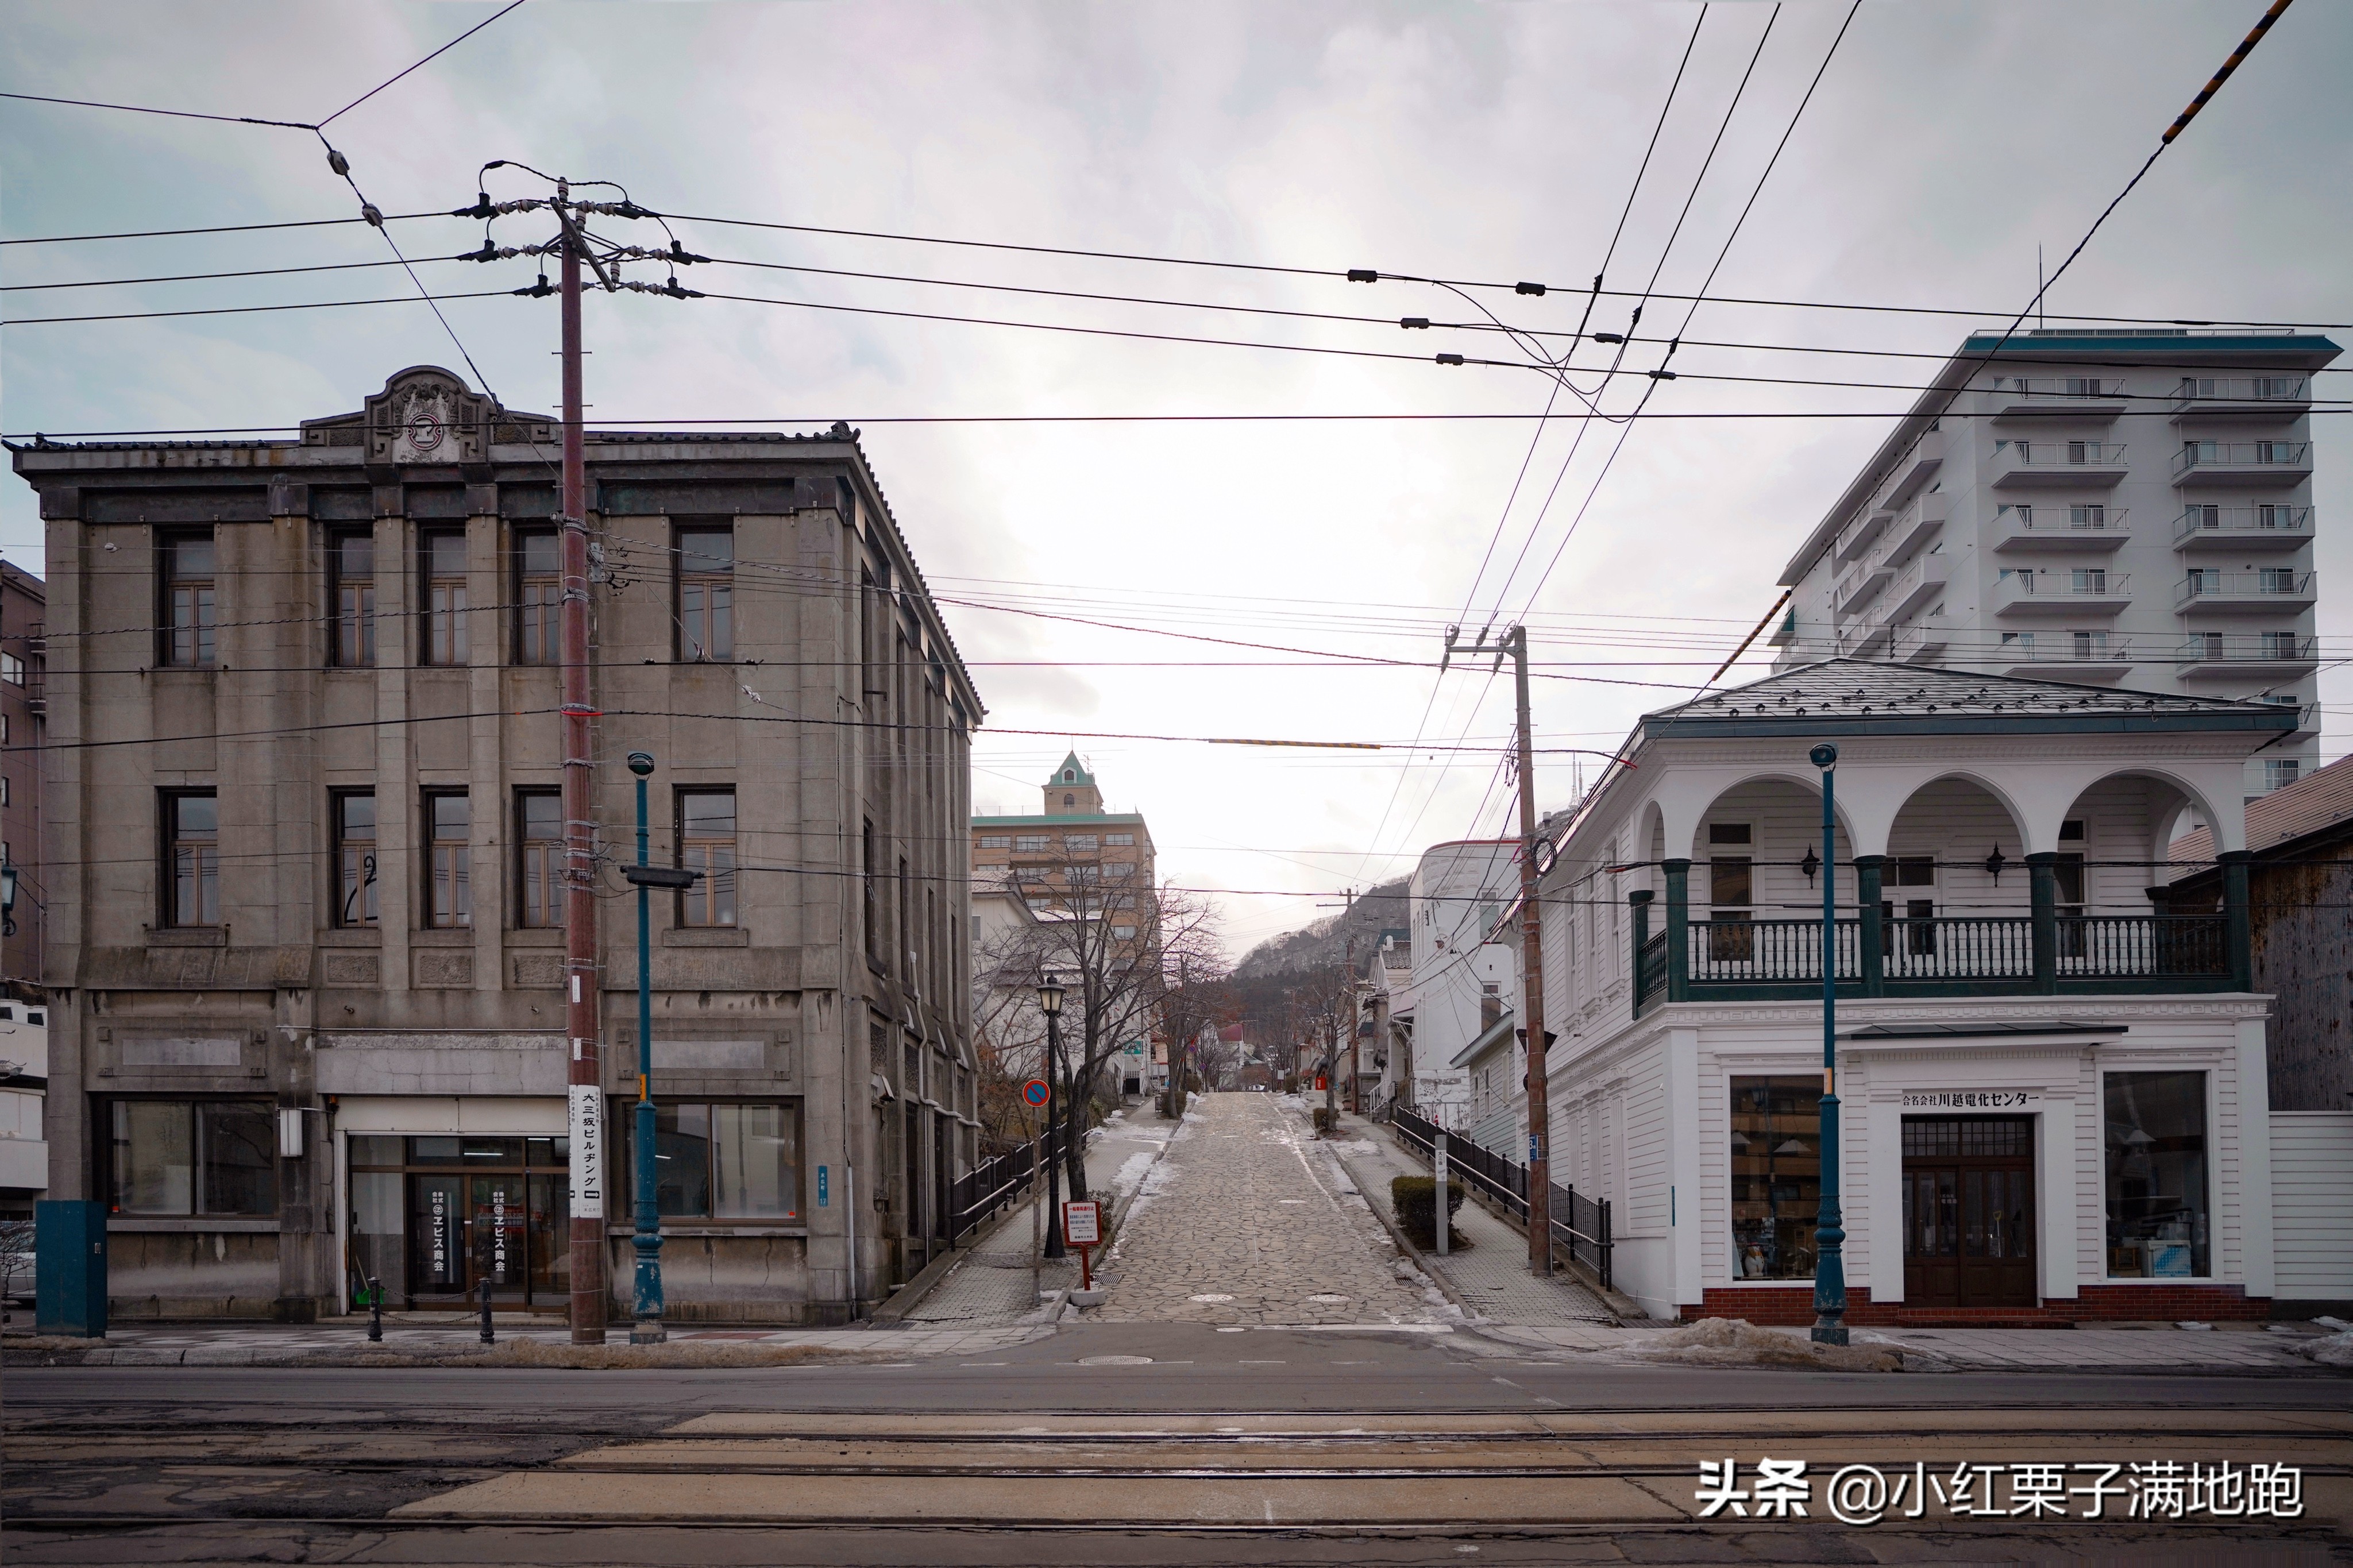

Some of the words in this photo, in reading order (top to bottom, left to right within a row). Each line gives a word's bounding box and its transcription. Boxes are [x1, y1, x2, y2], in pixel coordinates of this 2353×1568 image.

[583, 1094, 596, 1186] 大三坂ビルヂング
[433, 1216, 443, 1271] ヱビス商会
[494, 1216, 505, 1271] ヱビス商会
